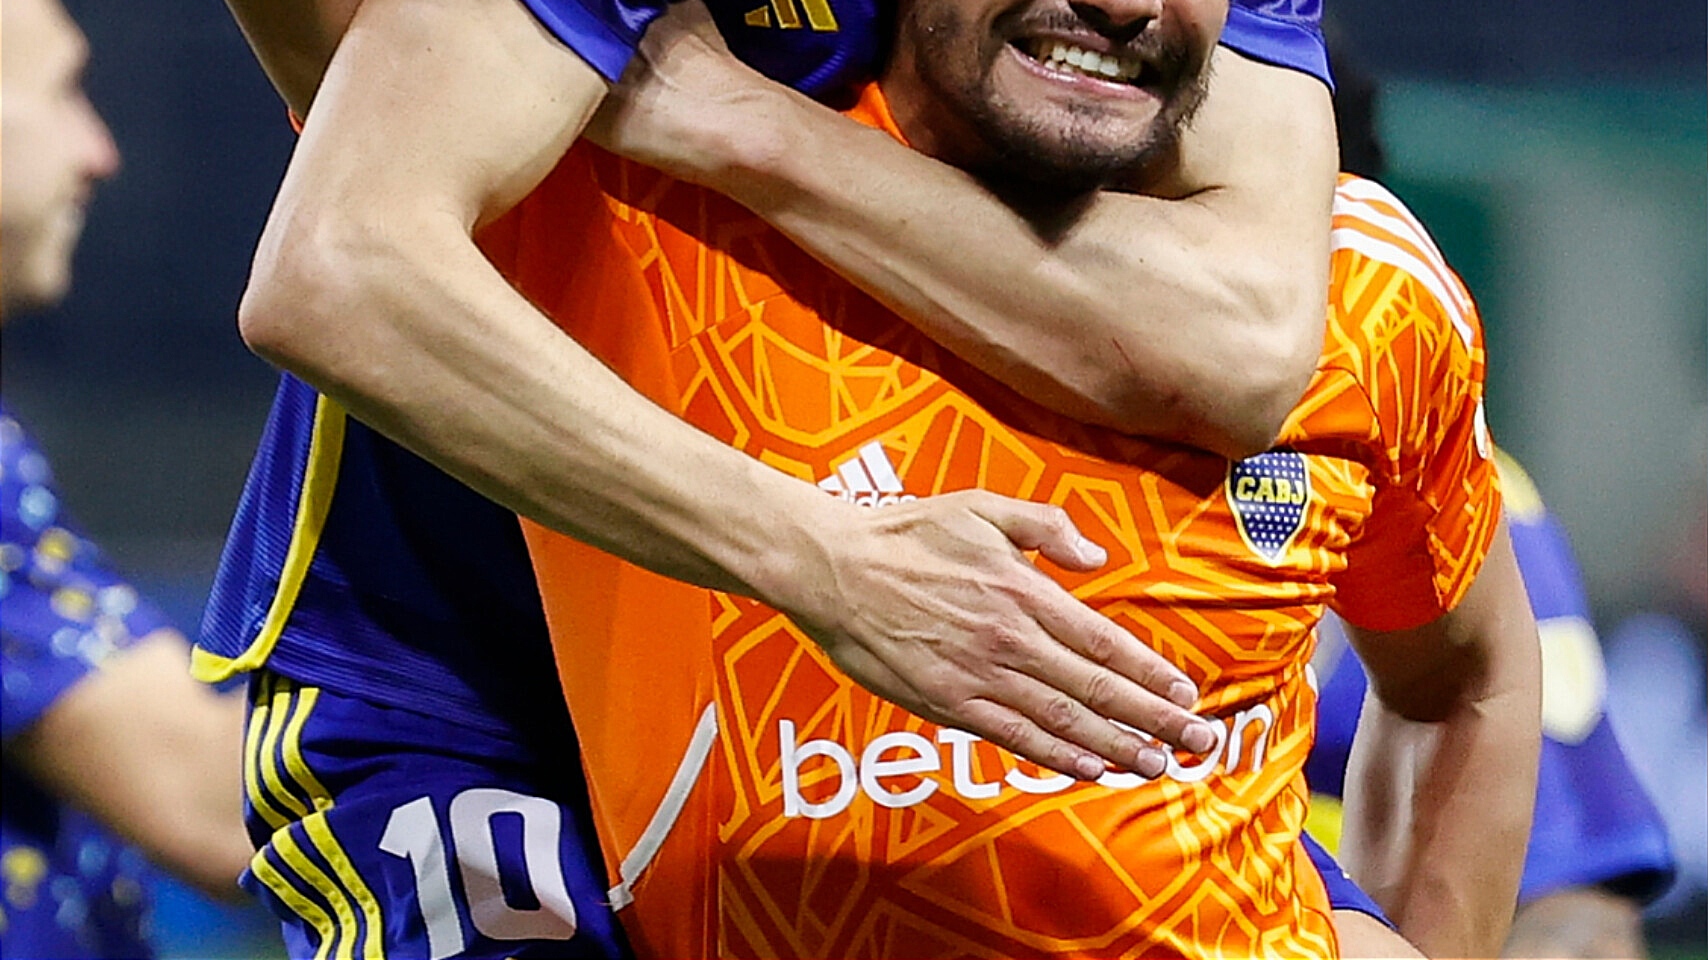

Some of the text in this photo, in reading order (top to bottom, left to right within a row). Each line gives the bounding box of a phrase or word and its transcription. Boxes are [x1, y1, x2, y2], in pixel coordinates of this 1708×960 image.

[1235, 476, 1305, 505] CABJ
[779, 702, 1274, 820] beton
[378, 787, 577, 960] 10
